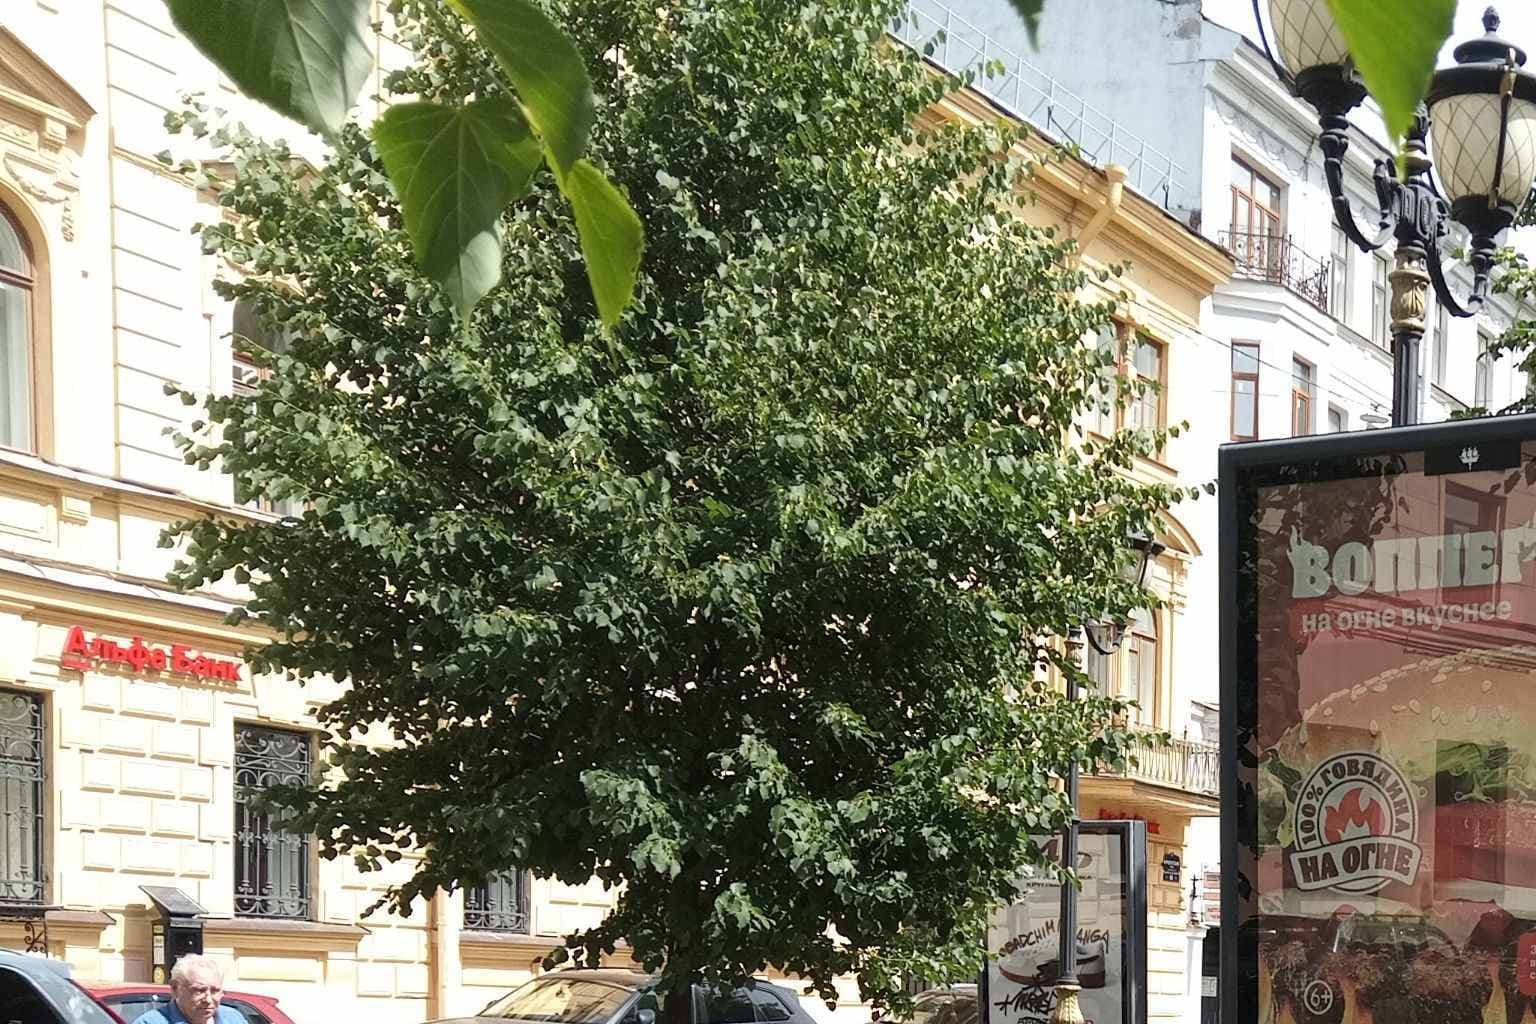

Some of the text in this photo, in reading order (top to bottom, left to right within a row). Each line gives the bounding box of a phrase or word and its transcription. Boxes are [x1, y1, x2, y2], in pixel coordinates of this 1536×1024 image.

[1302, 600, 1513, 633] на огне вкуснее
[1320, 758, 1411, 834] ГОВЯДИНА
[1298, 842, 1414, 883] НА ОГНЕ
[1530, 960, 1536, 968] в
[1530, 972, 1536, 980] с
[1310, 988, 1331, 1007] 6+
